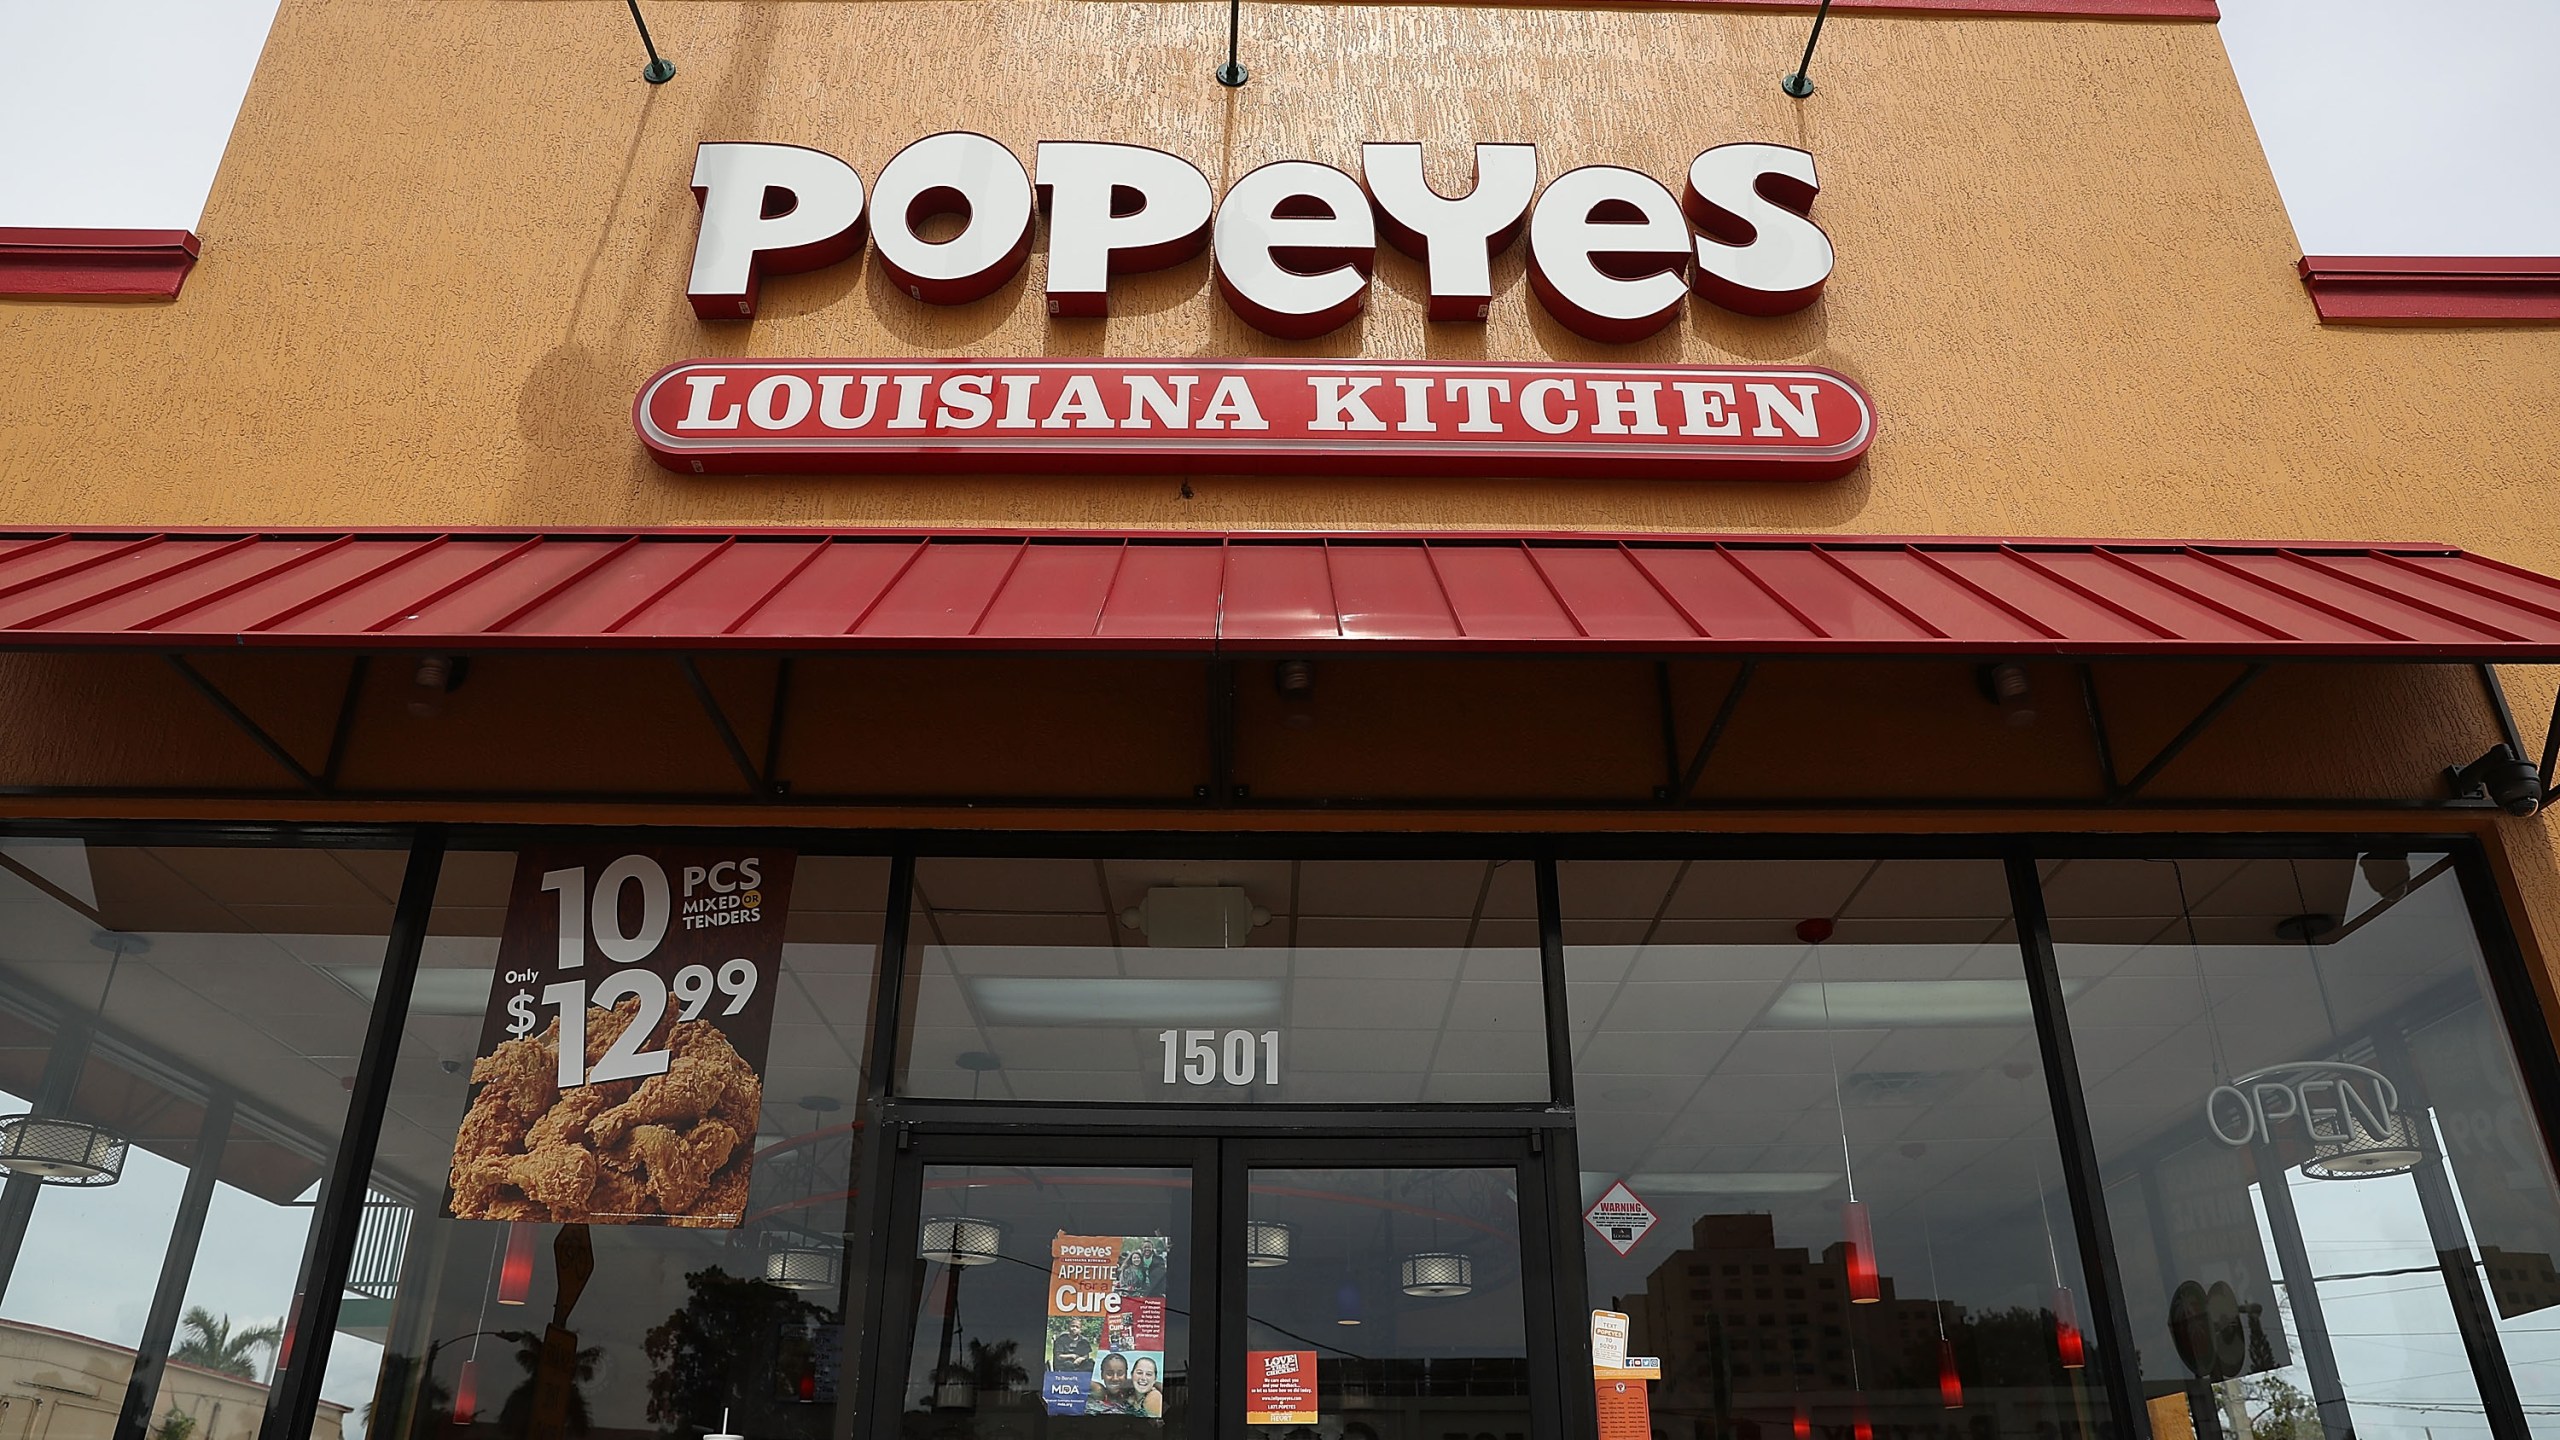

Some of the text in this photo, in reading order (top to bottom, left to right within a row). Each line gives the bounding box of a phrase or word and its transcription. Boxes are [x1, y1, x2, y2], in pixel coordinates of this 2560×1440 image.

[676, 374, 1822, 438] LOUISIANA KITCHEN
[541, 854, 762, 970] 10 PCS
[682, 893, 759, 914] MIXED OR
[683, 908, 761, 930] TENDERS
[505, 968, 539, 984] Only
[1160, 1029, 1279, 1086] 1501
[2207, 1079, 2392, 1146] OPEN
[1600, 1202, 1642, 1212] WARNING
[1058, 1264, 1118, 1280] APPETITE
[1079, 1281, 1108, 1291] for a
[1055, 1284, 1122, 1313] Cure
[1596, 1329, 1622, 1337] POPEYES
[1263, 1355, 1296, 1367] LOVE
[1051, 1384, 1080, 1395] MDA
